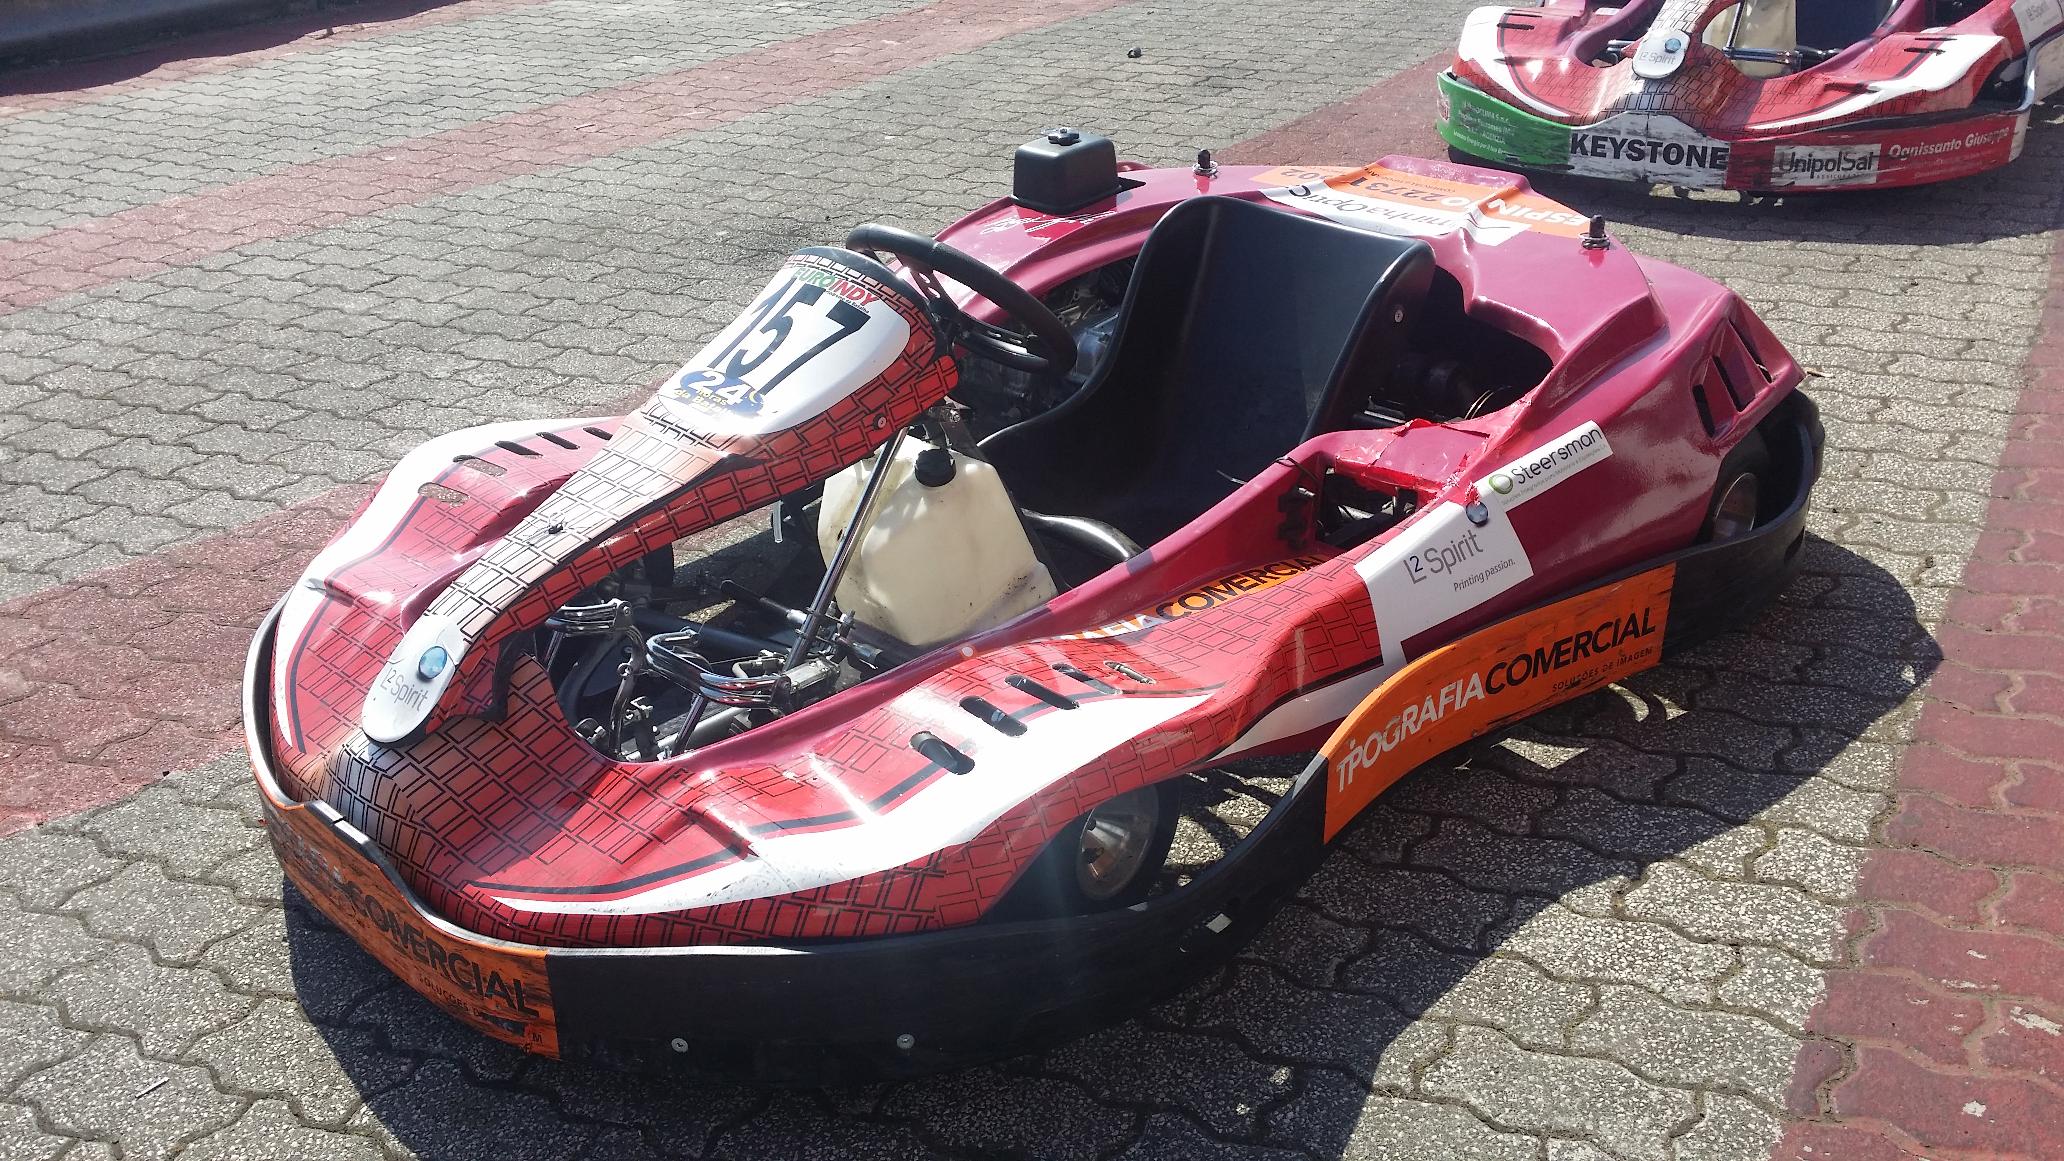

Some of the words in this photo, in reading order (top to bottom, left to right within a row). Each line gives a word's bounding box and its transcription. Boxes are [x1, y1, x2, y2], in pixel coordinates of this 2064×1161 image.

[1571, 133, 1730, 169] KEYSTONE
[707, 275, 871, 396] 157
[686, 369, 752, 405] 24
[1511, 427, 1602, 486] Steersman
[1423, 530, 1484, 576] Spirit
[1453, 572, 1485, 592] Printing
[1484, 557, 1516, 581] passion.
[1616, 647, 1654, 667] IMAGEM
[391, 674, 428, 711] Spirit
